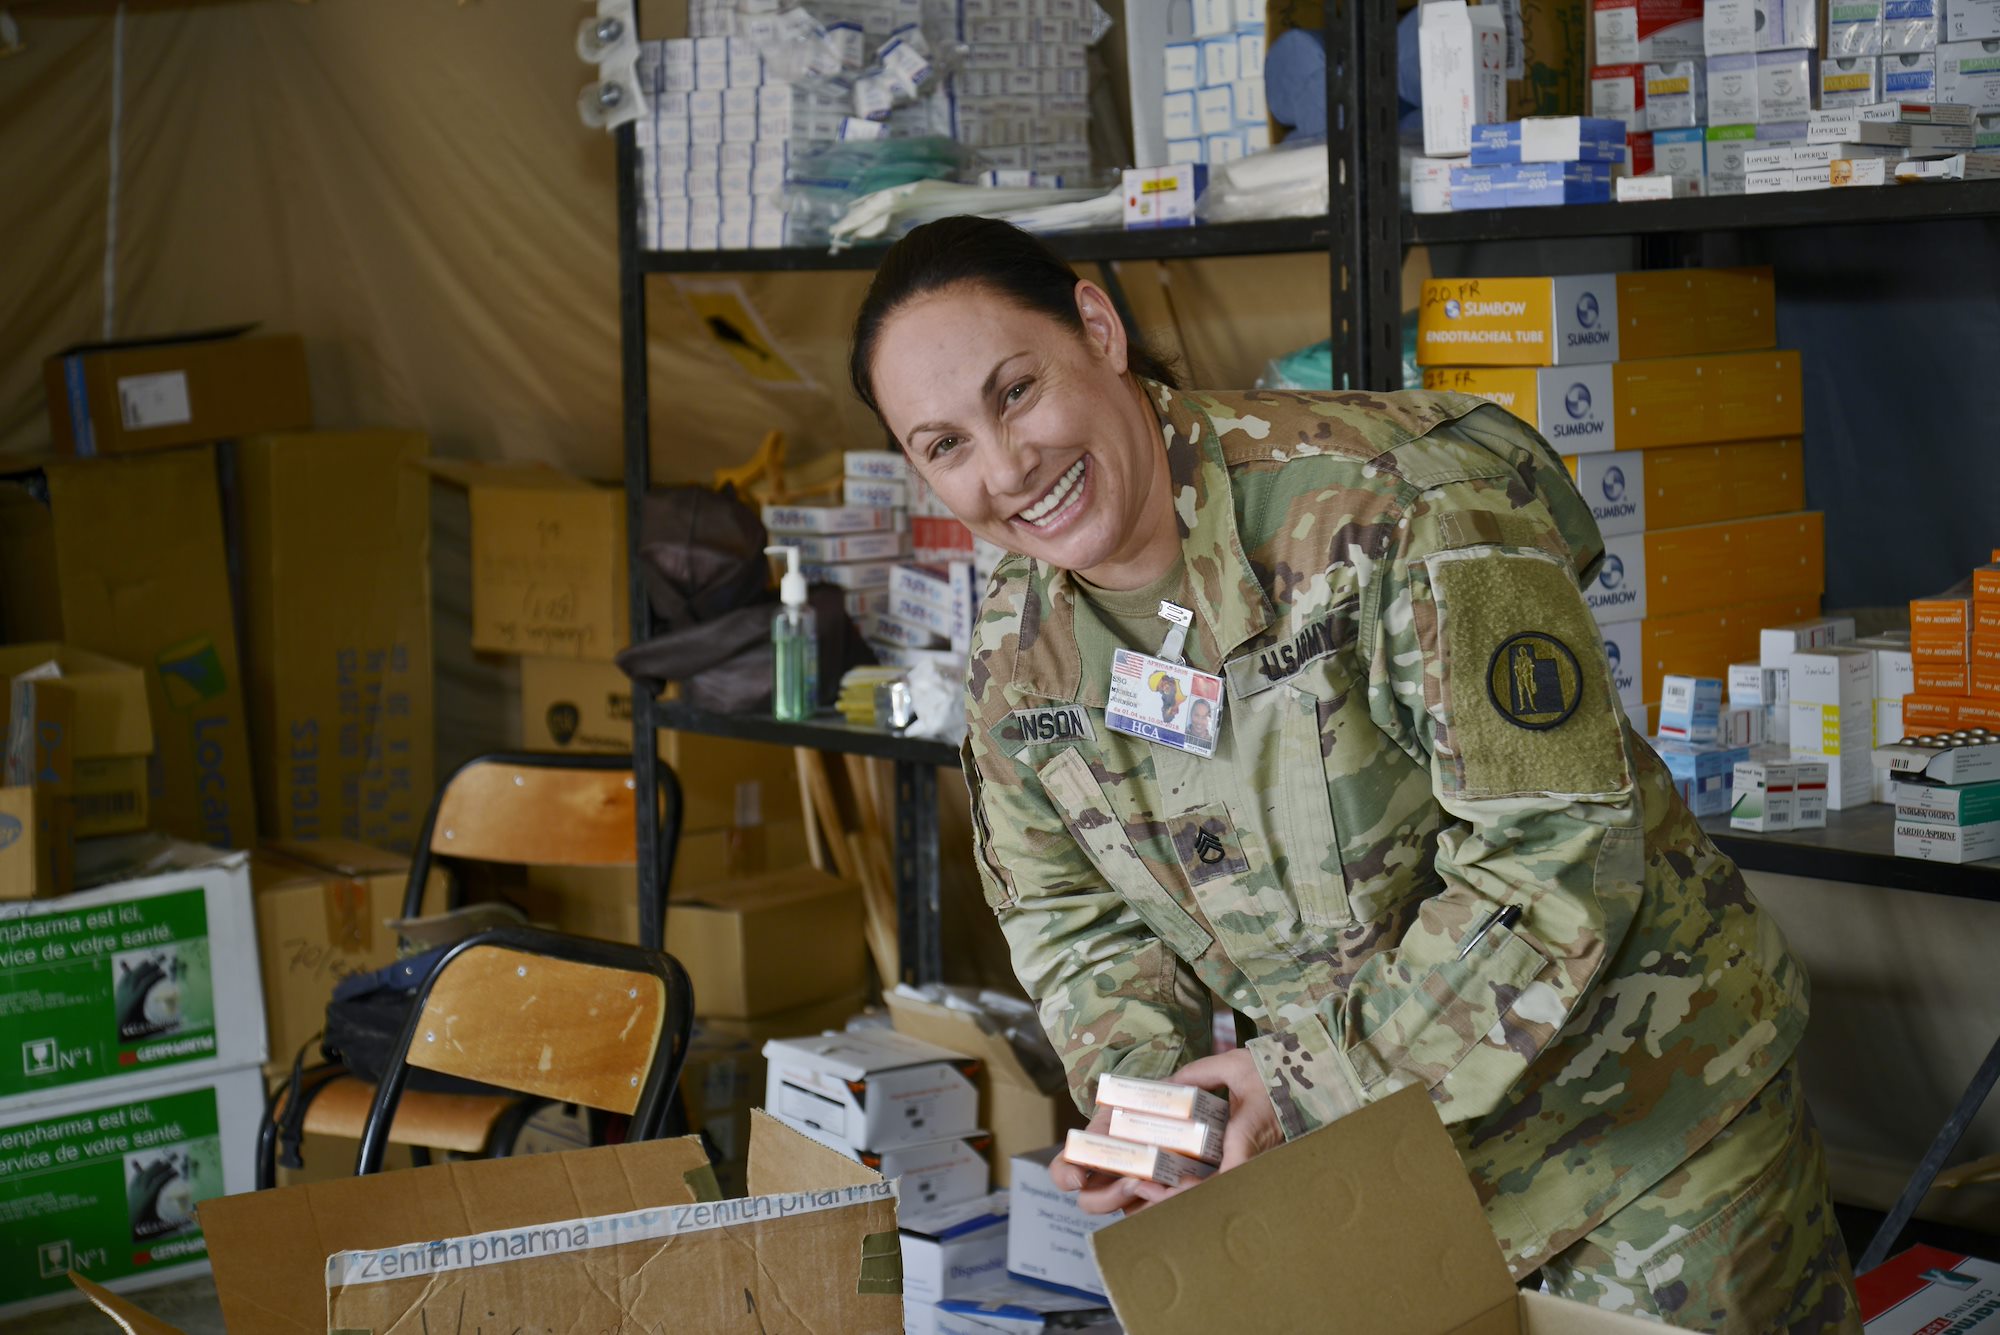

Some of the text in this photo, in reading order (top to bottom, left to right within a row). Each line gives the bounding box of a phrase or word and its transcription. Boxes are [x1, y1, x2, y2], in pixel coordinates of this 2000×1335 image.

[1810, 126, 1847, 135] LOPERIUM
[1746, 155, 1781, 164] LOPERIUM
[1793, 150, 1828, 160] LOPERIUM
[1528, 178, 1548, 190] 200
[1747, 176, 1781, 186] LOPERIUM
[1795, 172, 1830, 183] LOPERIUM
[1474, 181, 1492, 193] 200
[1458, 280, 1480, 299] FR
[1464, 301, 1526, 318] SUMBOW
[1426, 330, 1544, 344] ENDOTRACHEAL TUBE
[1568, 331, 1610, 346] SUMBOW
[1554, 421, 1604, 437] SUMBOW
[1593, 503, 1636, 520] SUMBOW
[1588, 591, 1637, 608] SUMBOW
[1112, 676, 1127, 685] SSG
[1018, 710, 1085, 741] NSON
[1132, 720, 1160, 739] HCA
[1897, 826, 1925, 839] CARDIO
[1925, 829, 1957, 842] ASPIRINE
[86, 909, 114, 928] est
[41, 942, 65, 960] de
[71, 934, 117, 956] votre
[0, 1117, 94, 1150] enpharma
[98, 1109, 126, 1129] est
[55, 1143, 79, 1161] de
[82, 1134, 129, 1157] votre
[361, 1242, 462, 1279] Zenith
[470, 1223, 590, 1267] pharma
[677, 1195, 771, 1230] Zenith
[1945, 1289, 1993, 1319] CASTING
